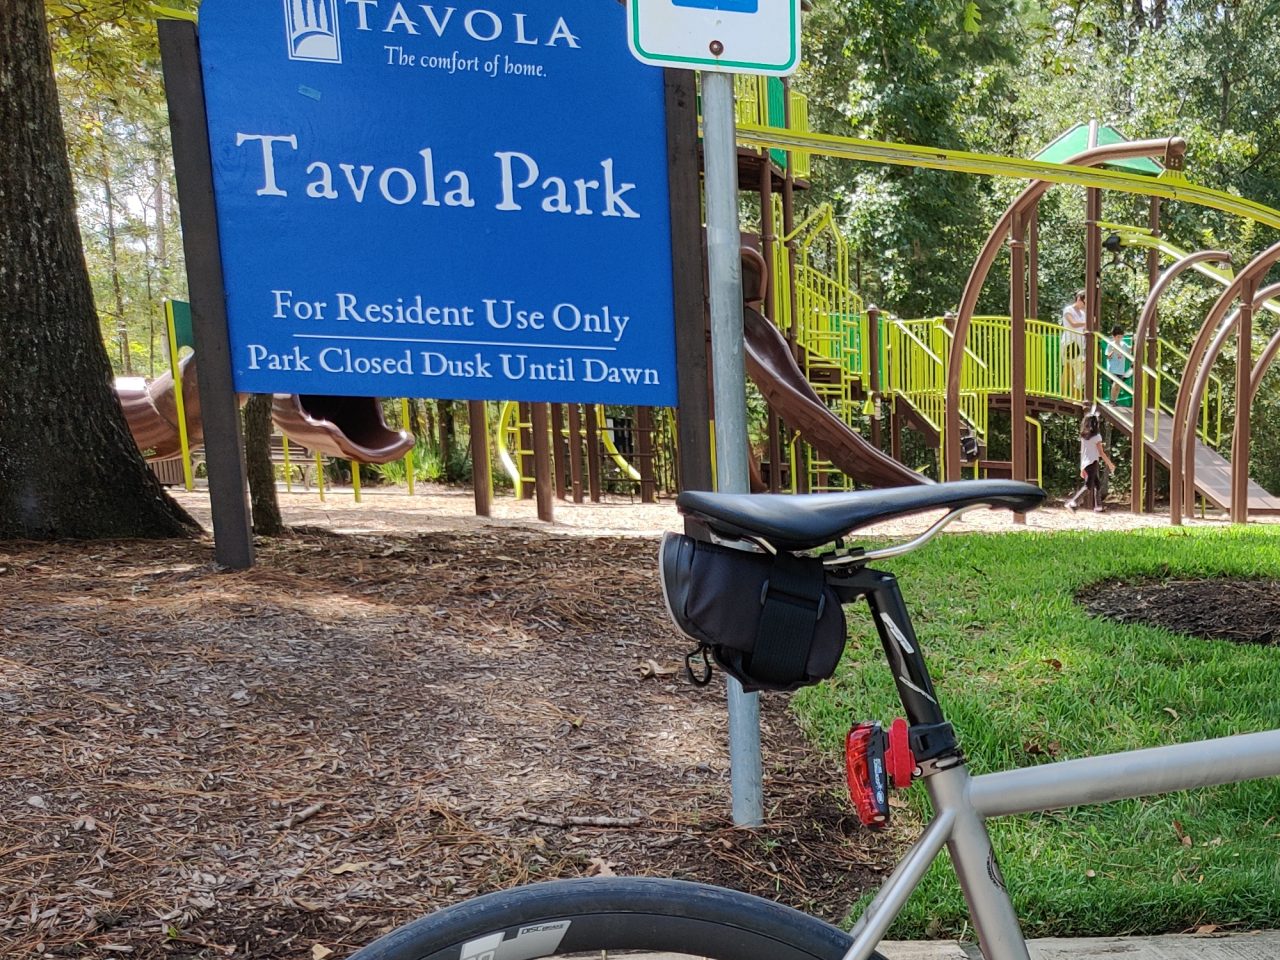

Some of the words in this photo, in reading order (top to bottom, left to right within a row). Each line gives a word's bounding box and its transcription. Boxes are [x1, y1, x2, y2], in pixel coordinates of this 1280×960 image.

[345, 0, 581, 49] TAVOLA
[384, 46, 416, 68] The
[420, 49, 480, 73] comfort
[484, 54, 502, 77] of
[504, 56, 547, 77] home.
[236, 132, 474, 208] Tavola
[495, 151, 640, 218] Park
[272, 290, 326, 320] For
[336, 293, 474, 328] Resident
[484, 299, 545, 331] Use
[552, 305, 630, 341] Only
[247, 344, 311, 373] Park
[319, 348, 414, 377] Closed
[422, 352, 493, 379] Dusk
[500, 354, 575, 382] Until
[583, 358, 660, 386] Dawn
